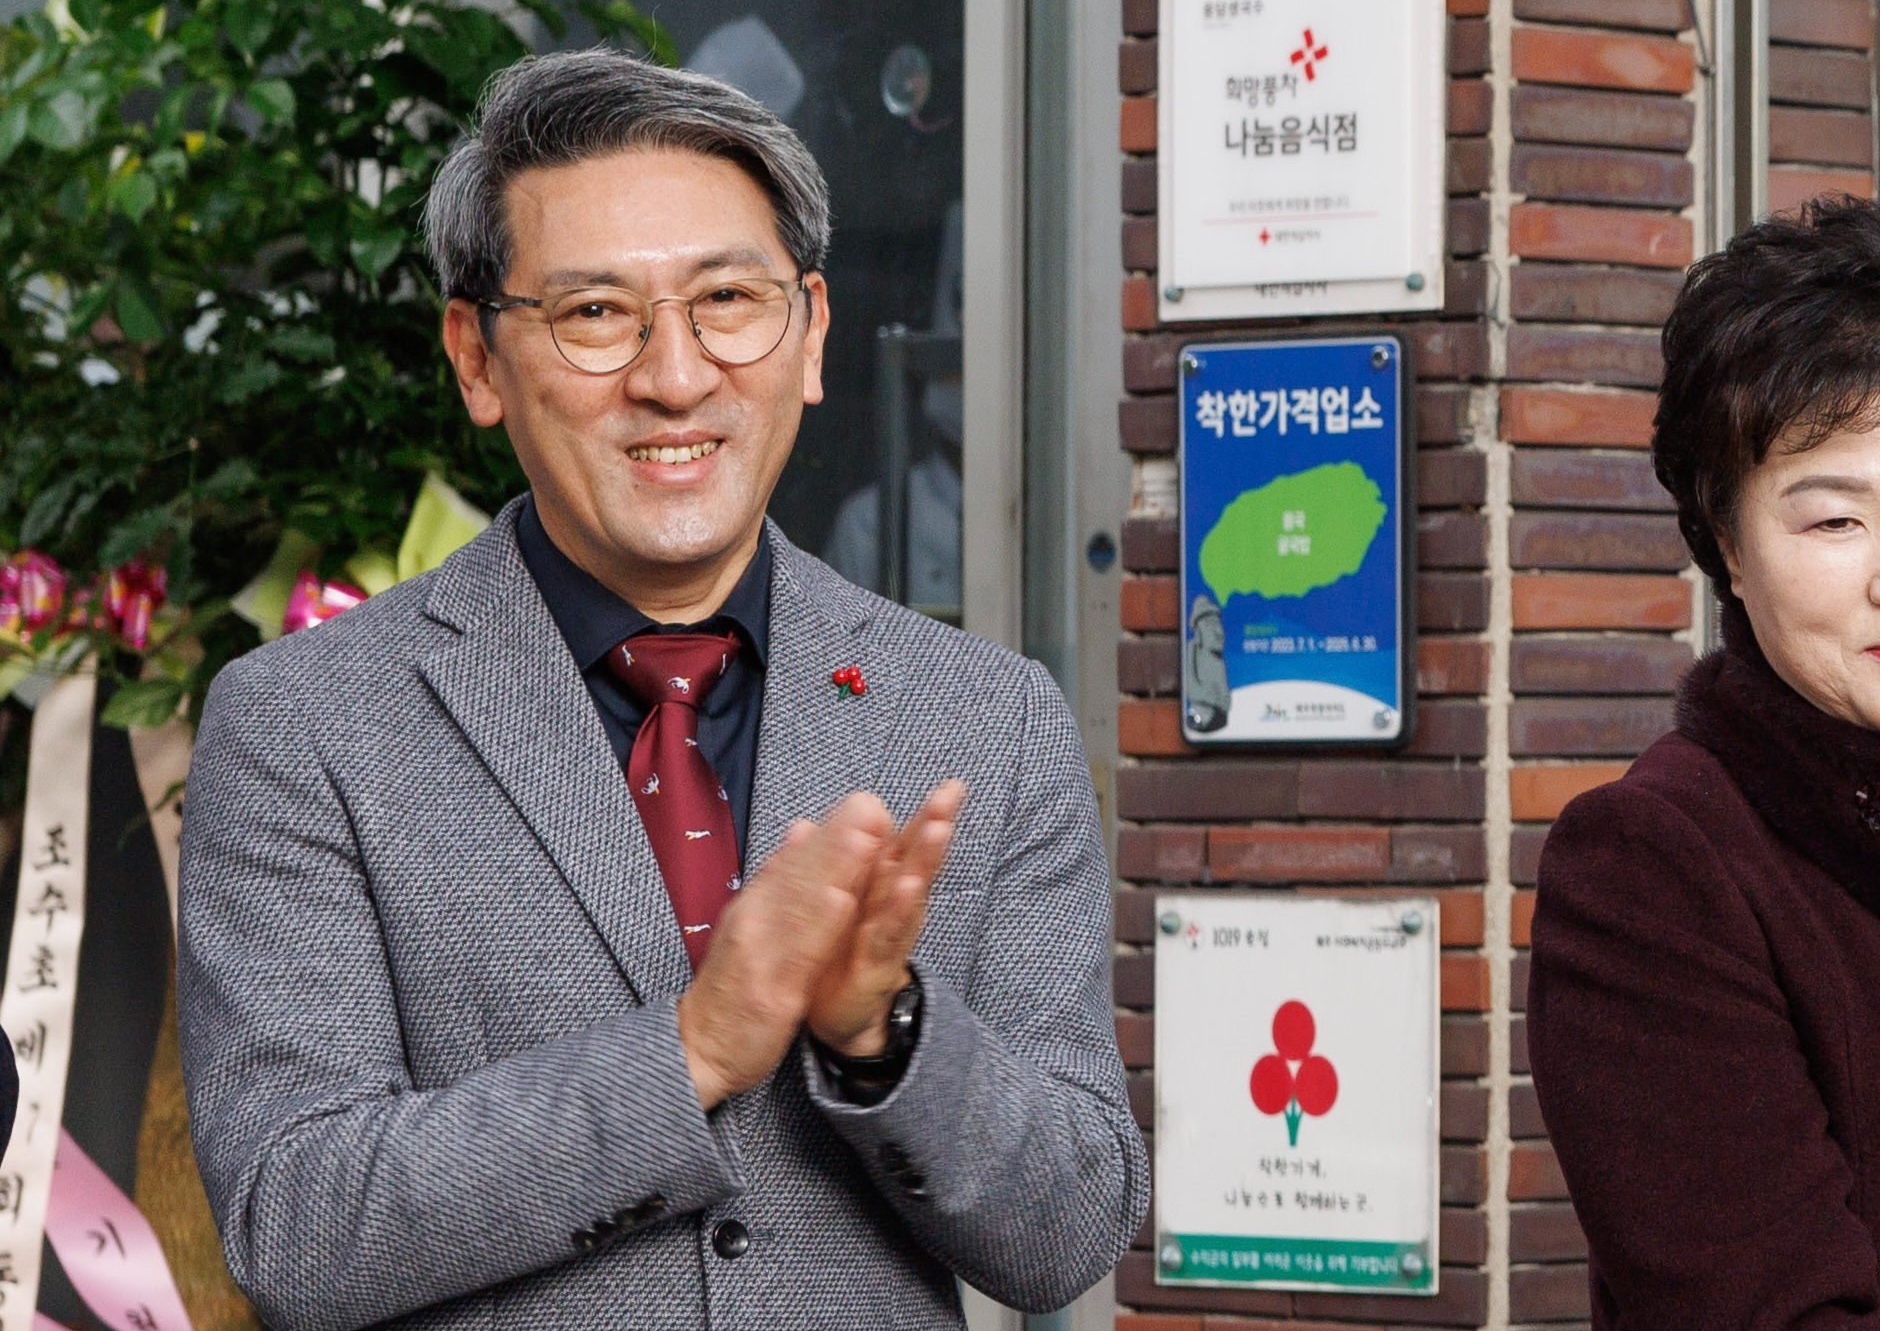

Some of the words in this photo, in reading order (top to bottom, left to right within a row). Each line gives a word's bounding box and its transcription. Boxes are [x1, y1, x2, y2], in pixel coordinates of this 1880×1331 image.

[1226, 72, 1298, 108] 희망풍차
[1225, 112, 1358, 158] 나눔음식점
[1195, 384, 1385, 439] 착한가격업소
[1212, 926, 1241, 949] 1019
